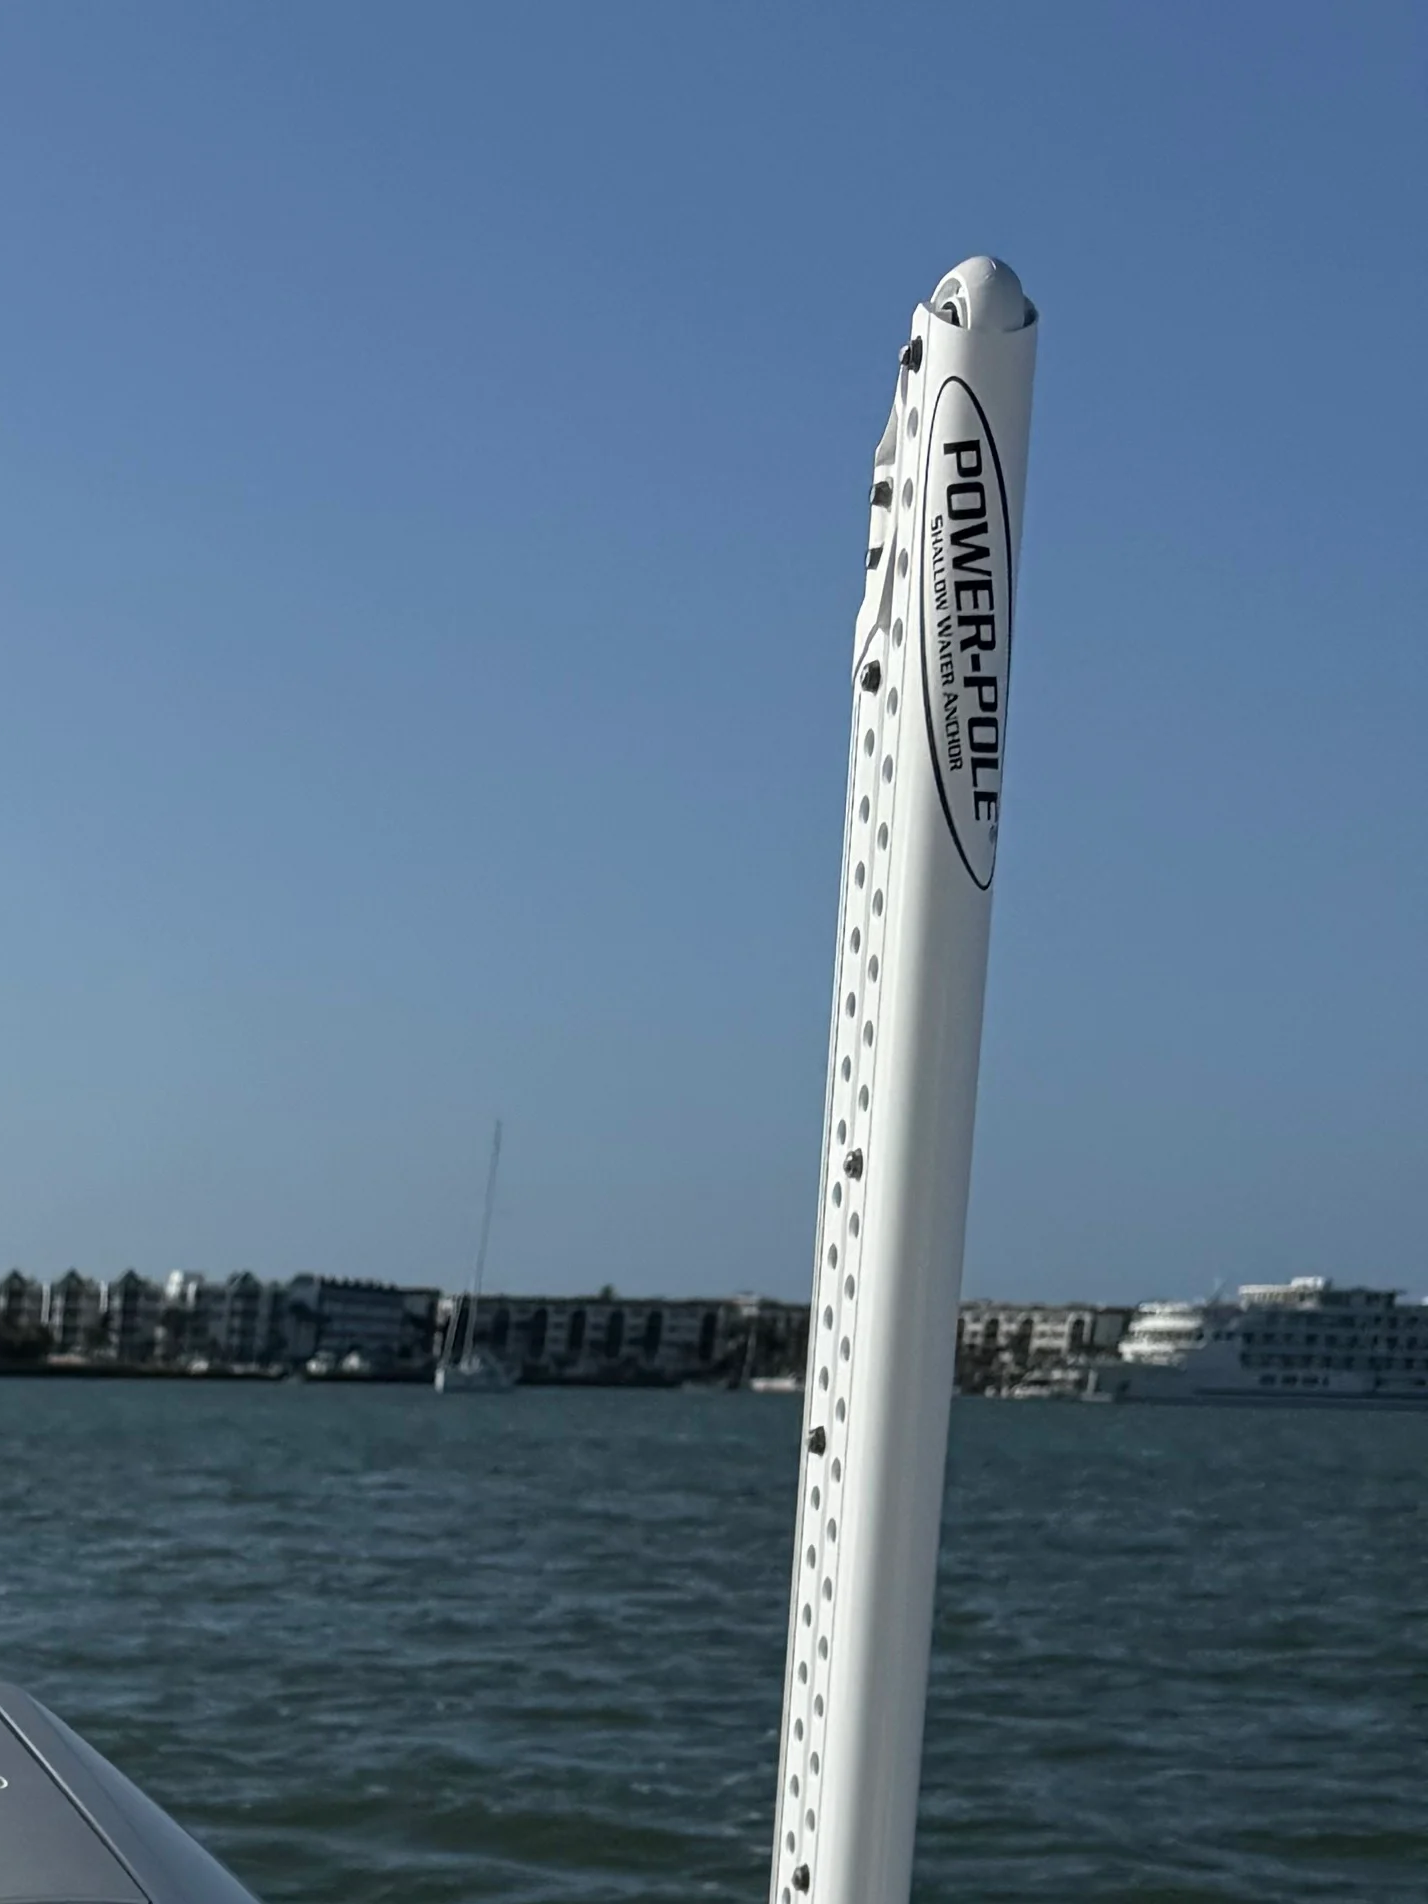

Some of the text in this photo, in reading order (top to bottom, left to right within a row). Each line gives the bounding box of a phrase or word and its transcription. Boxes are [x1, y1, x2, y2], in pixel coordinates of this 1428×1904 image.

[930, 513, 950, 611] SHALLOW
[942, 689, 964, 773] ANCHOR
[943, 437, 1000, 822] POWER-POLE
